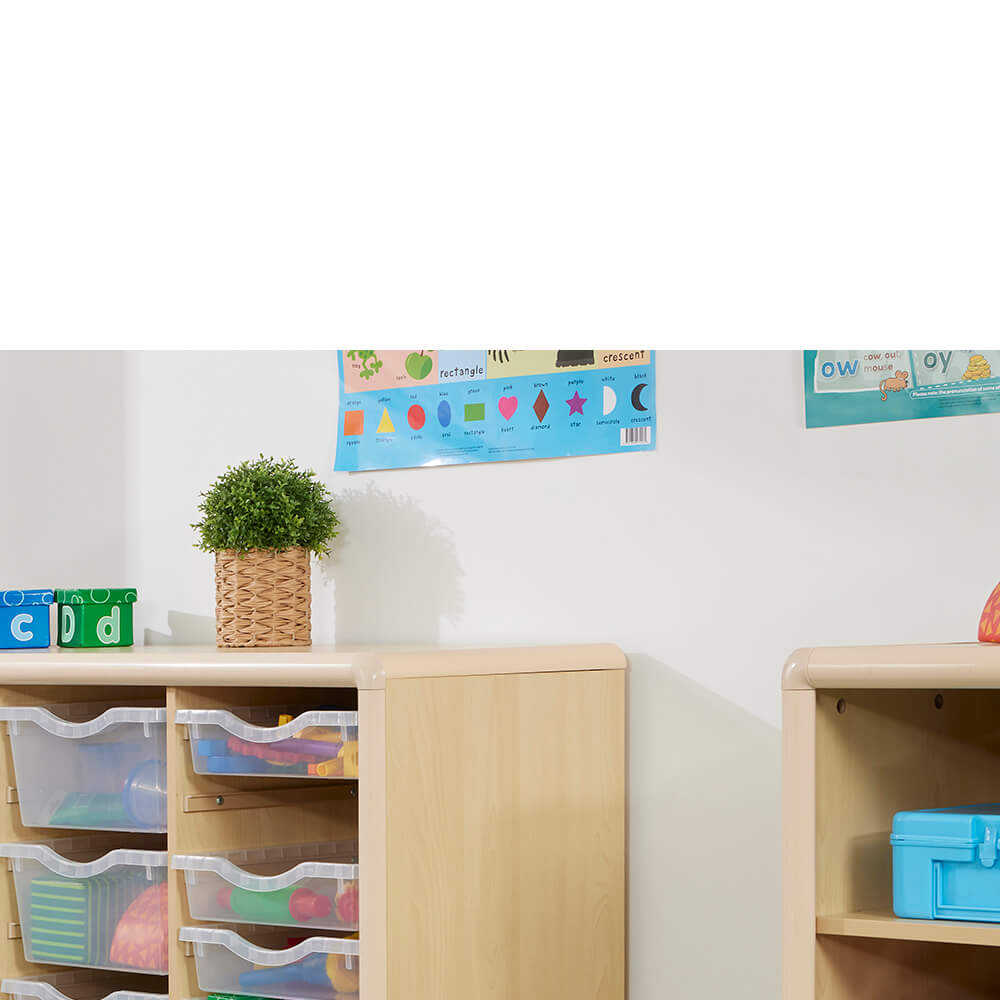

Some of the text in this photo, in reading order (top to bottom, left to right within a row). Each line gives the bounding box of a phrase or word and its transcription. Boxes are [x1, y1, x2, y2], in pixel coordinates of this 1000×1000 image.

[603, 350, 645, 363] crescent
[821, 359, 859, 378] ow
[923, 350, 953, 374] oy
[440, 365, 484, 378] rectangle
[11, 613, 34, 642] c
[61, 605, 76, 644] D
[96, 606, 120, 644] d
